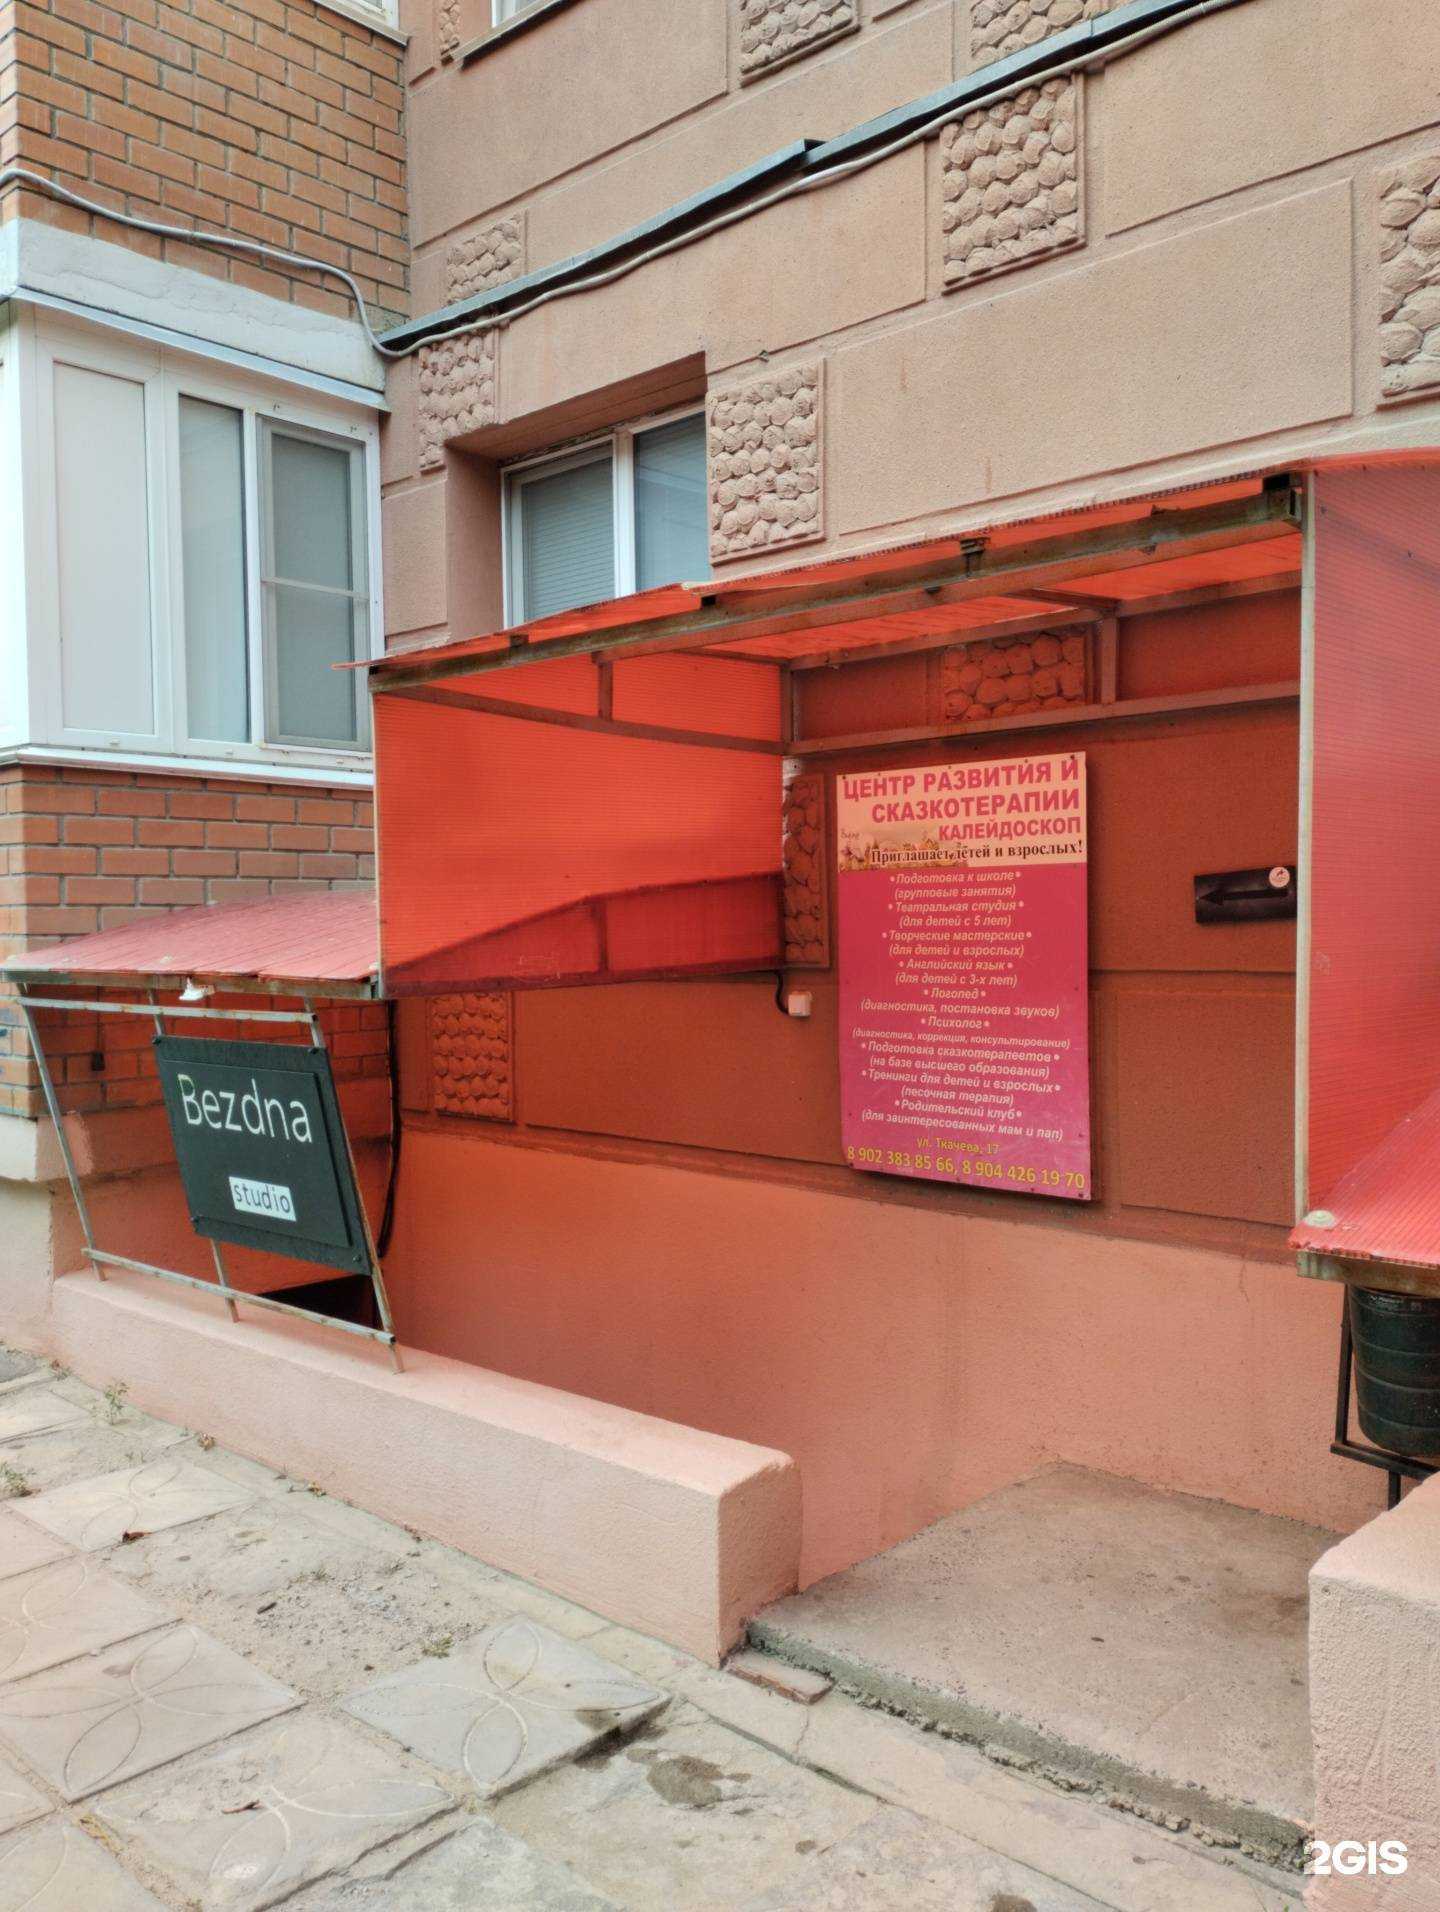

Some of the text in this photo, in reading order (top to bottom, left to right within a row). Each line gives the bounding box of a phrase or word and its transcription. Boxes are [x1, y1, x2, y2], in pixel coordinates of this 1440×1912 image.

[843, 759, 1079, 800] ЦЕНТР РАЗВИТИЯ И
[871, 788, 1080, 823] СКАЗКОТЕРАПИИ
[938, 816, 1081, 841] КАЛЕЙДОСКОП
[995, 846, 1004, 857] и
[1008, 840, 1083, 861] взрослых!
[896, 871, 1015, 884] Подготовка к школе
[894, 884, 1016, 900] (групповые занятия)
[896, 899, 1016, 914] Театральная студия
[899, 914, 1011, 928] (для детей с 5 лет)
[889, 930, 1025, 942] Творческие мастерские
[889, 944, 1024, 958] (для детей и взрослых)
[906, 958, 1005, 970] Английский язык
[895, 972, 918, 985] (для
[921, 973, 957, 984] детей
[969, 974, 986, 984] 3-х
[989, 974, 1018, 988] лет)
[930, 987, 979, 999] Логопед
[860, 997, 1060, 1019] (диагностика, постановка звуков)
[928, 1015, 982, 1029] Психолог
[852, 1027, 1071, 1050] (диагностика, коррекция, консультирование)
[868, 1041, 1051, 1062] Подготовка сказкотерапевтов
[869, 1056, 1050, 1080] (на базе высшего образования)
[868, 1068, 1053, 1093] Тренинги для детей и взрослых
[901, 1085, 1014, 1107] (песочная терапия)
[177, 1073, 312, 1143] Bezdna
[901, 1099, 1015, 1121] Родительский клуб
[862, 1109, 884, 1122] (для
[998, 1125, 1022, 1135] мам
[1026, 1128, 1034, 1136] и
[1036, 1128, 1064, 1142] пап)
[917, 1137, 932, 1148] ул.
[986, 1143, 1000, 1154] 17
[847, 1146, 1085, 1188] 8 902 383 85 66, 8 904 426 19 70
[233, 1183, 291, 1214] studio
